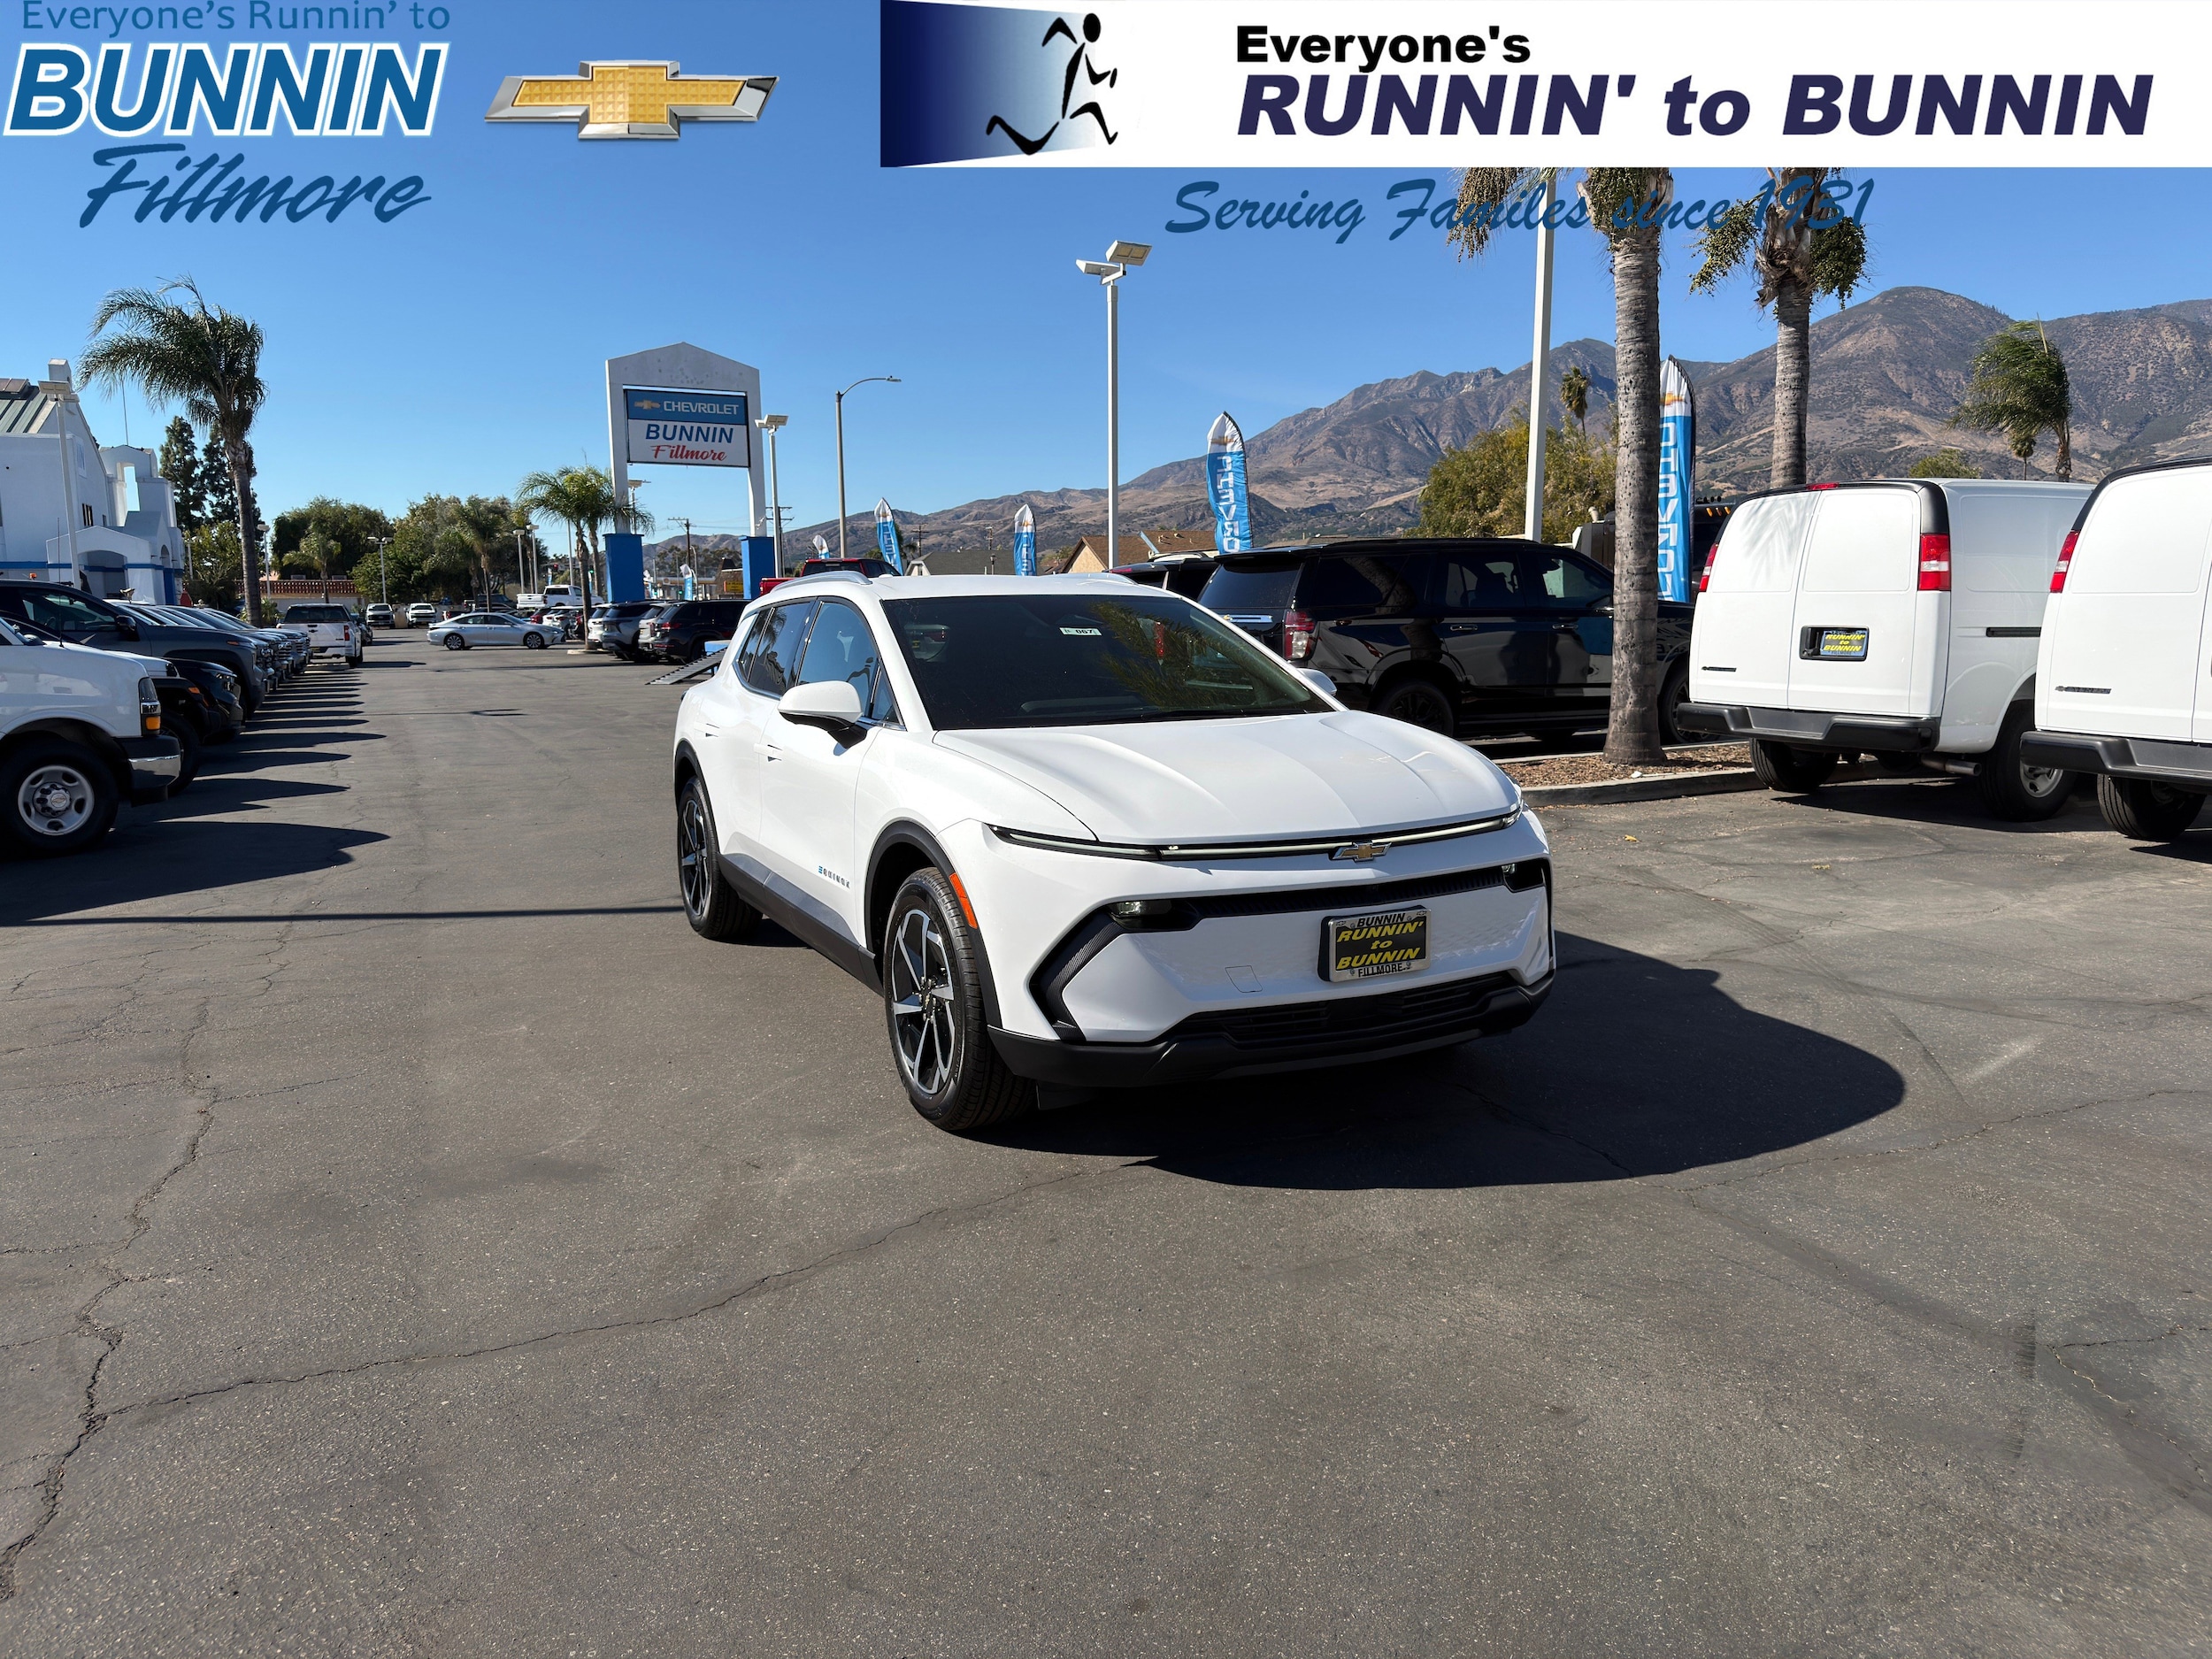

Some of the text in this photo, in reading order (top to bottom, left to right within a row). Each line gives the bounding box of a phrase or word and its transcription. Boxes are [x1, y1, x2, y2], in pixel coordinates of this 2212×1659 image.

[664, 401, 739, 415] CHEVROLET
[646, 424, 733, 443] BUNNIN
[649, 444, 727, 462] Fillmore
[1357, 913, 1405, 927] BUNNIN
[1336, 921, 1424, 942] RUNNIN'
[1371, 940, 1393, 949] to
[1336, 948, 1420, 970] BUNNIN
[1358, 963, 1402, 978] FILLMORE
